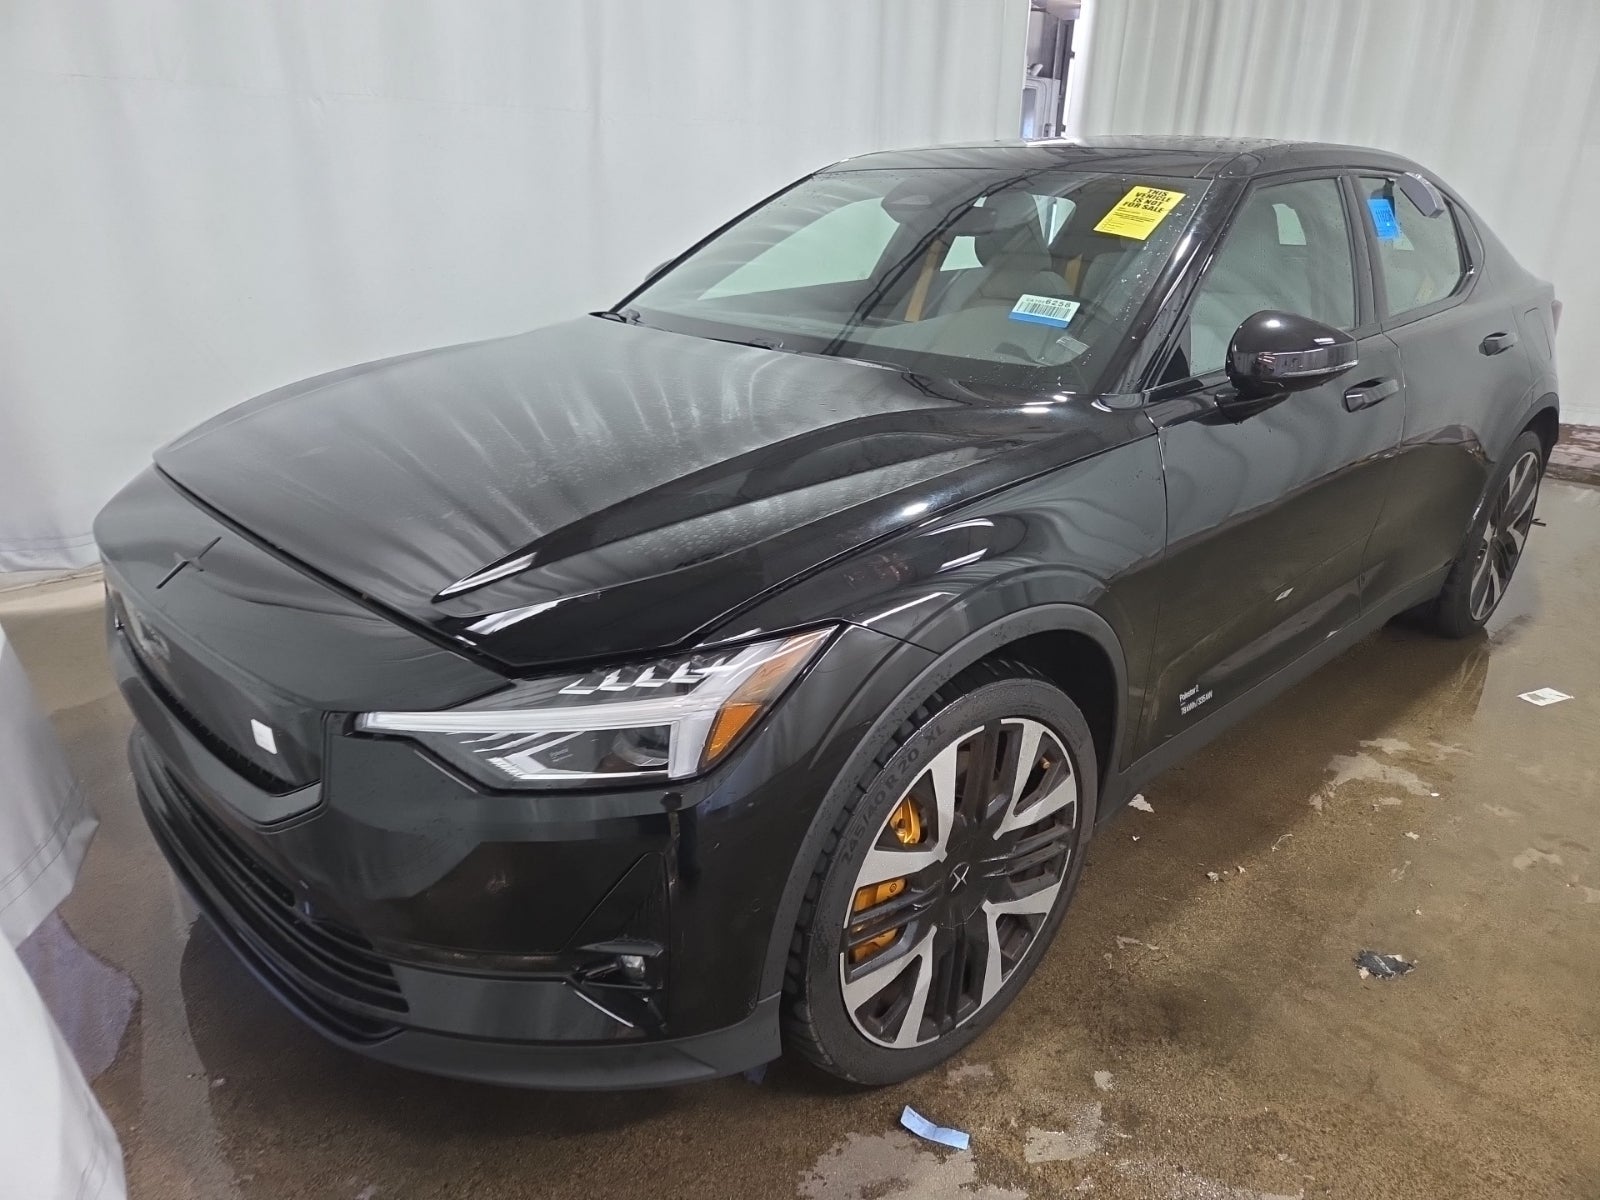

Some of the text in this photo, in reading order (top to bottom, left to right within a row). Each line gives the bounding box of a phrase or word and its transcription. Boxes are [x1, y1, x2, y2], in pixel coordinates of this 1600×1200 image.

[1135, 192, 1172, 202] VEHICLE
[1147, 188, 1168, 197] THIS
[1144, 199, 1164, 207] NOT
[1142, 204, 1164, 213] SALE
[1179, 687, 1196, 702] Polestar
[897, 747, 919, 774] 20
